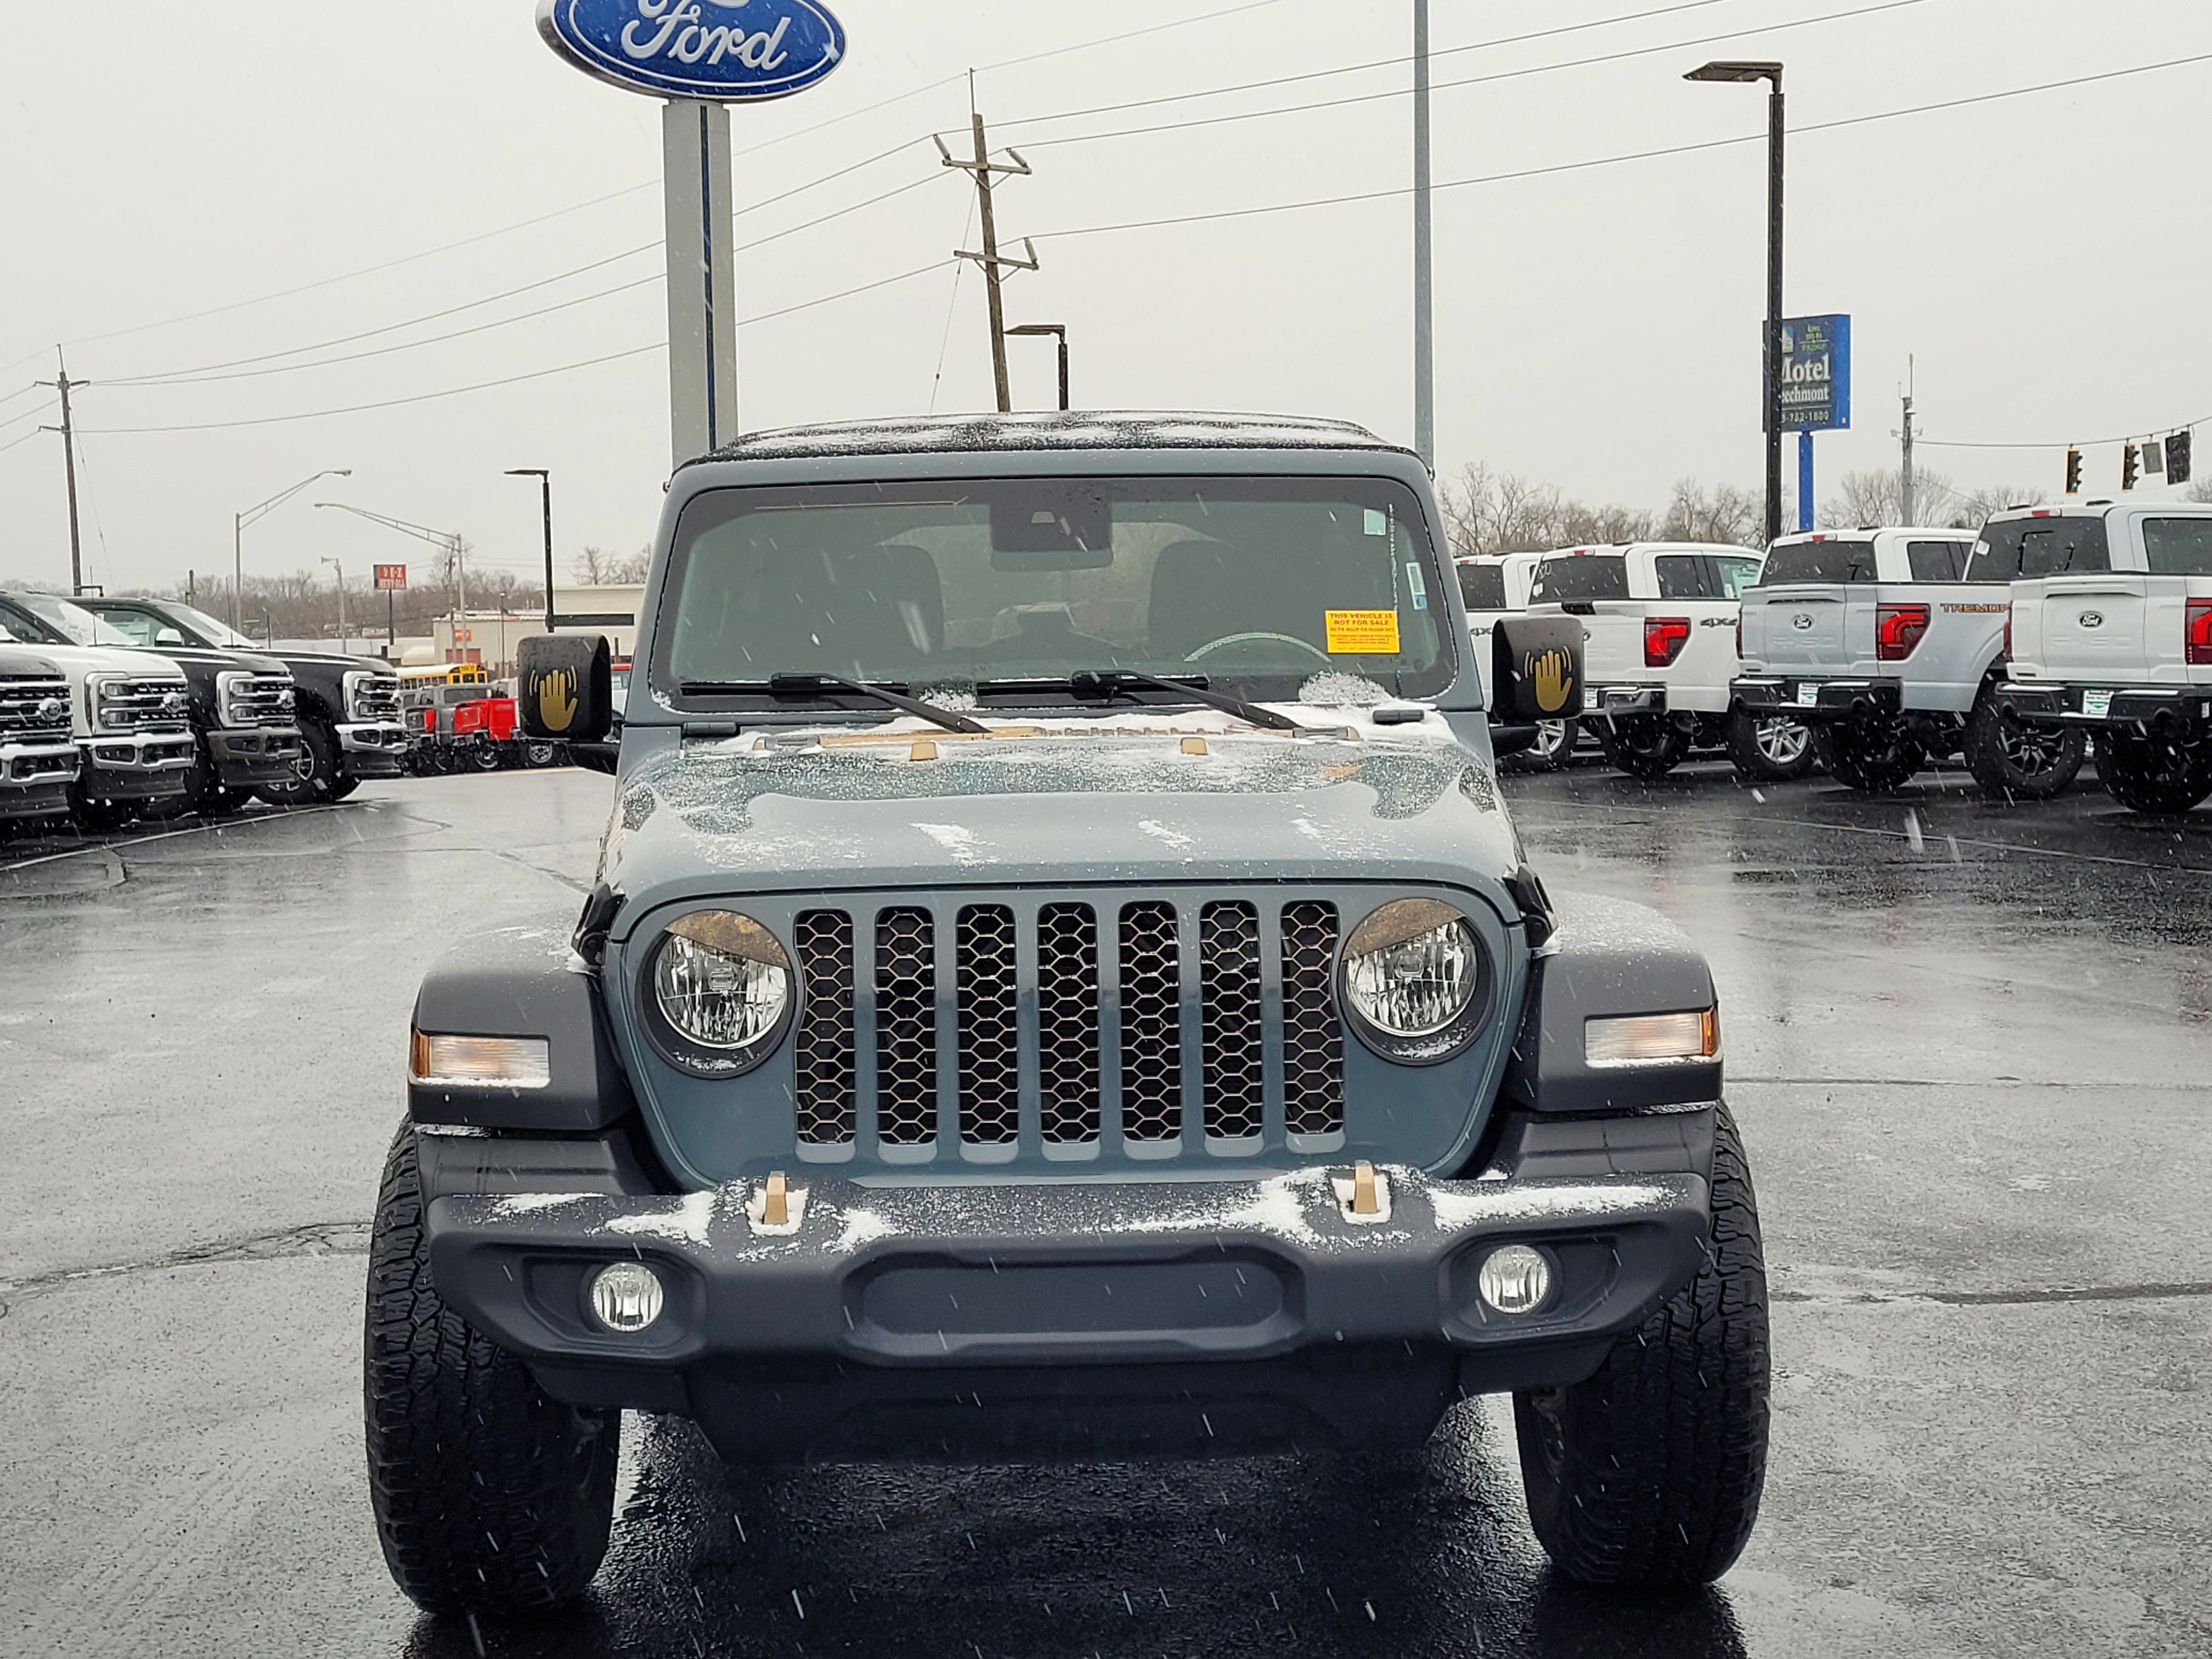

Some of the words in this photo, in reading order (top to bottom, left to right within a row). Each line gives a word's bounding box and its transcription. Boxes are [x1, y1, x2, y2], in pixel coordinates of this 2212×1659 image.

[620, 0, 791, 70] Ford
[1781, 352, 1831, 383] Motel
[1781, 385, 1830, 404] echmont
